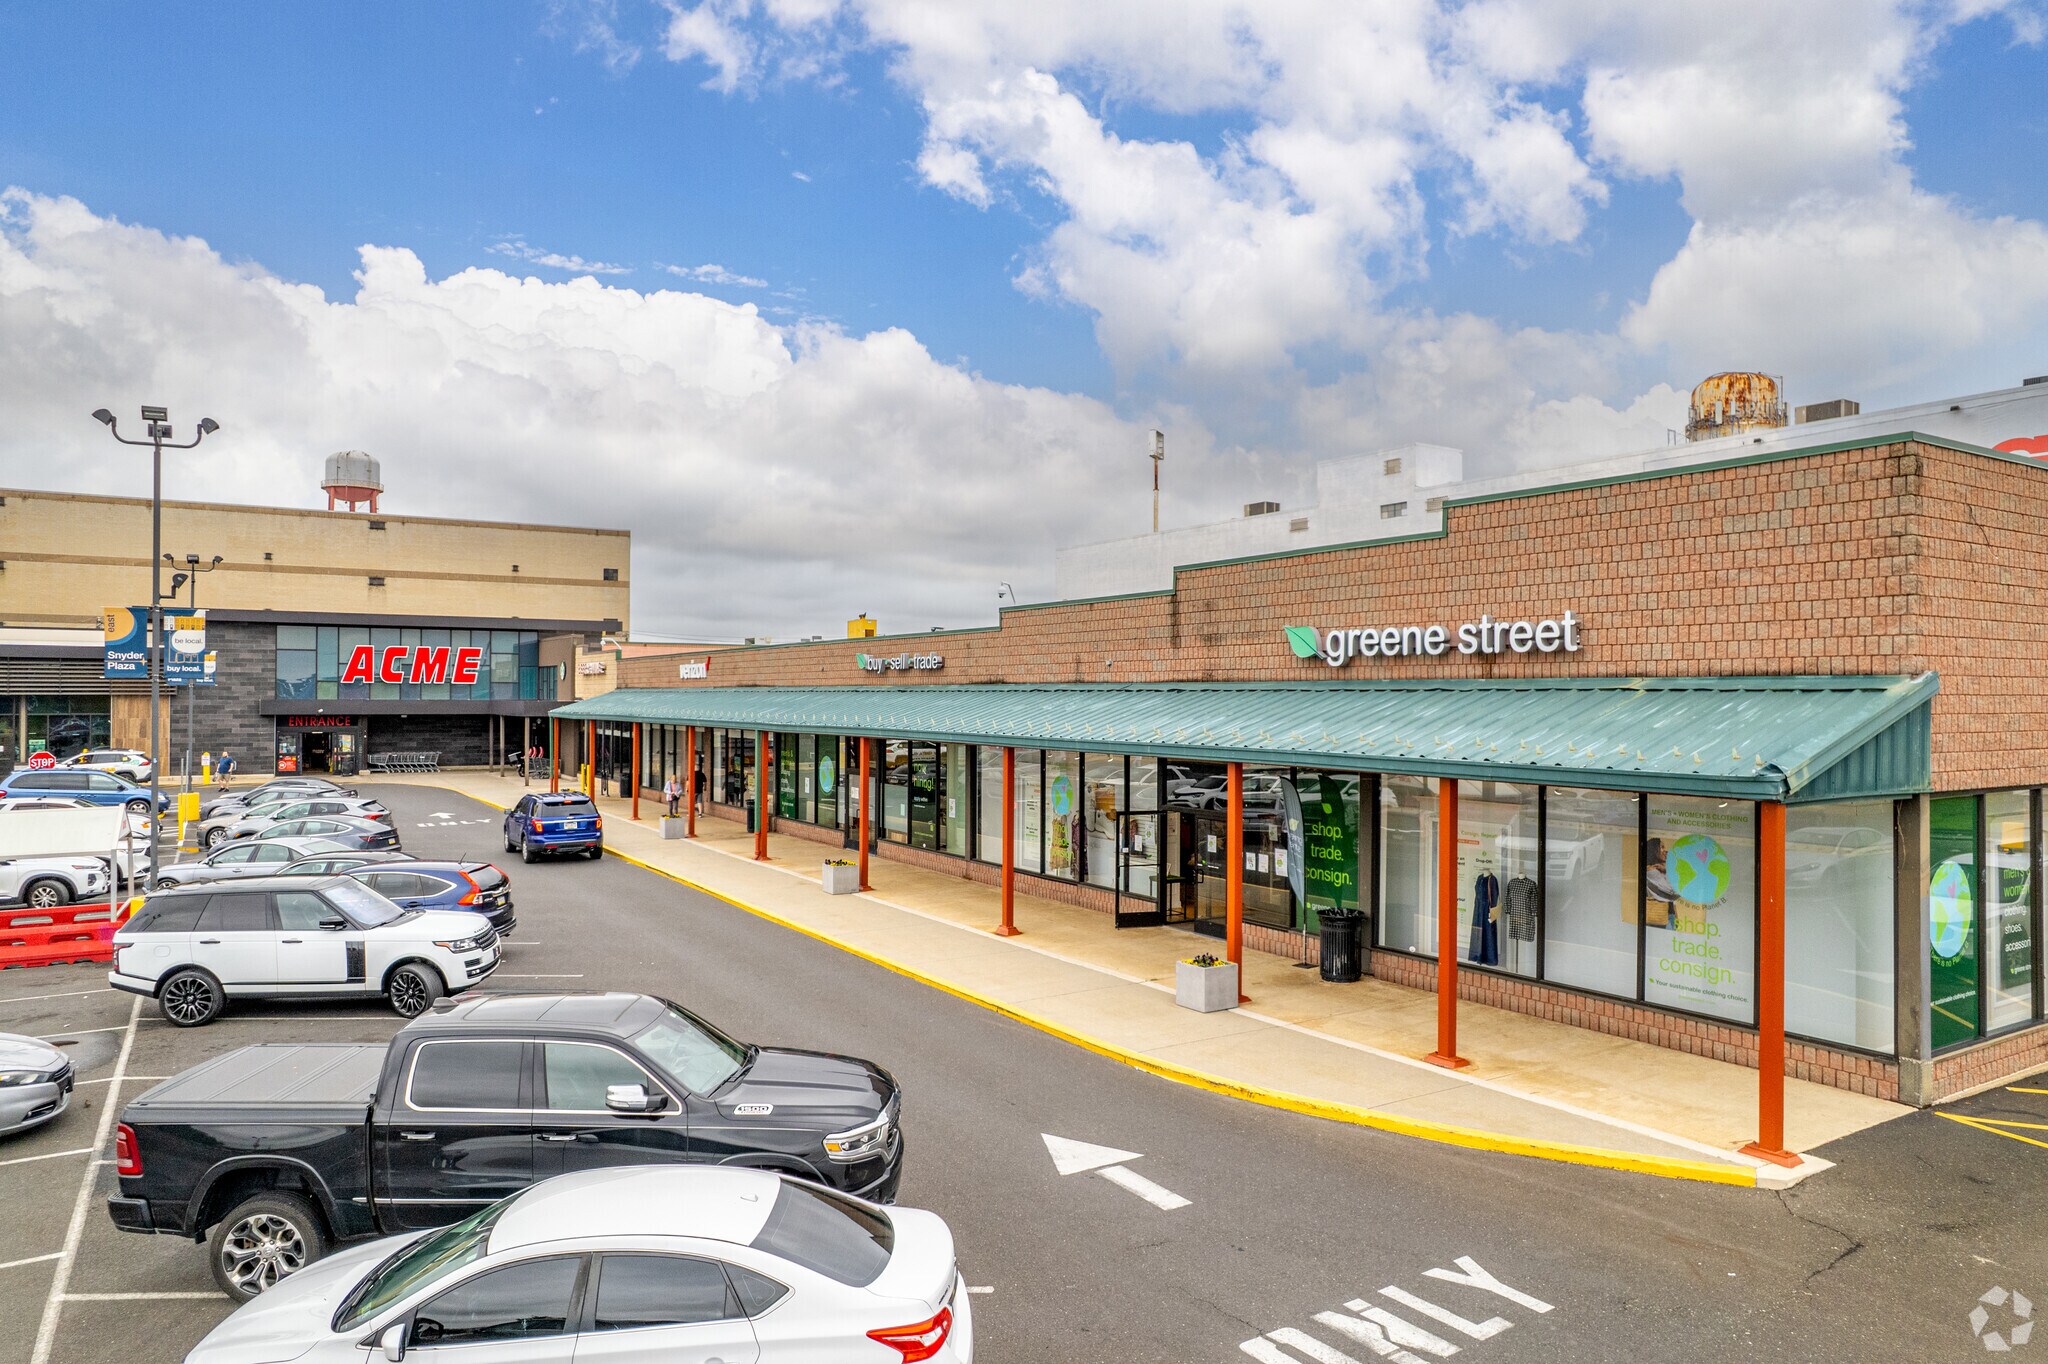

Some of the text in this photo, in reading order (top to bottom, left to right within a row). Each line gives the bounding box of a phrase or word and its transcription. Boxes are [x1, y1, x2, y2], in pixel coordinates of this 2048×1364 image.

[1325, 609, 1579, 668] greene street
[107, 650, 144, 661] Snyder
[340, 644, 483, 685] ACME
[867, 653, 938, 674] buy sell trade
[107, 661, 136, 671] Plaza
[166, 665, 181, 673] buy
[288, 715, 351, 727] ENTRANCE
[30, 758, 54, 768] STOP
[1711, 813, 1749, 823] CLOTHING
[1311, 821, 1344, 840] shop.
[1310, 843, 1345, 862] trade.
[1674, 915, 1722, 940] shop.
[1672, 936, 1722, 960] trade.
[1659, 958, 1736, 985] consign.
[1669, 982, 1702, 993] sustainable
[1702, 989, 1727, 999] clothing
